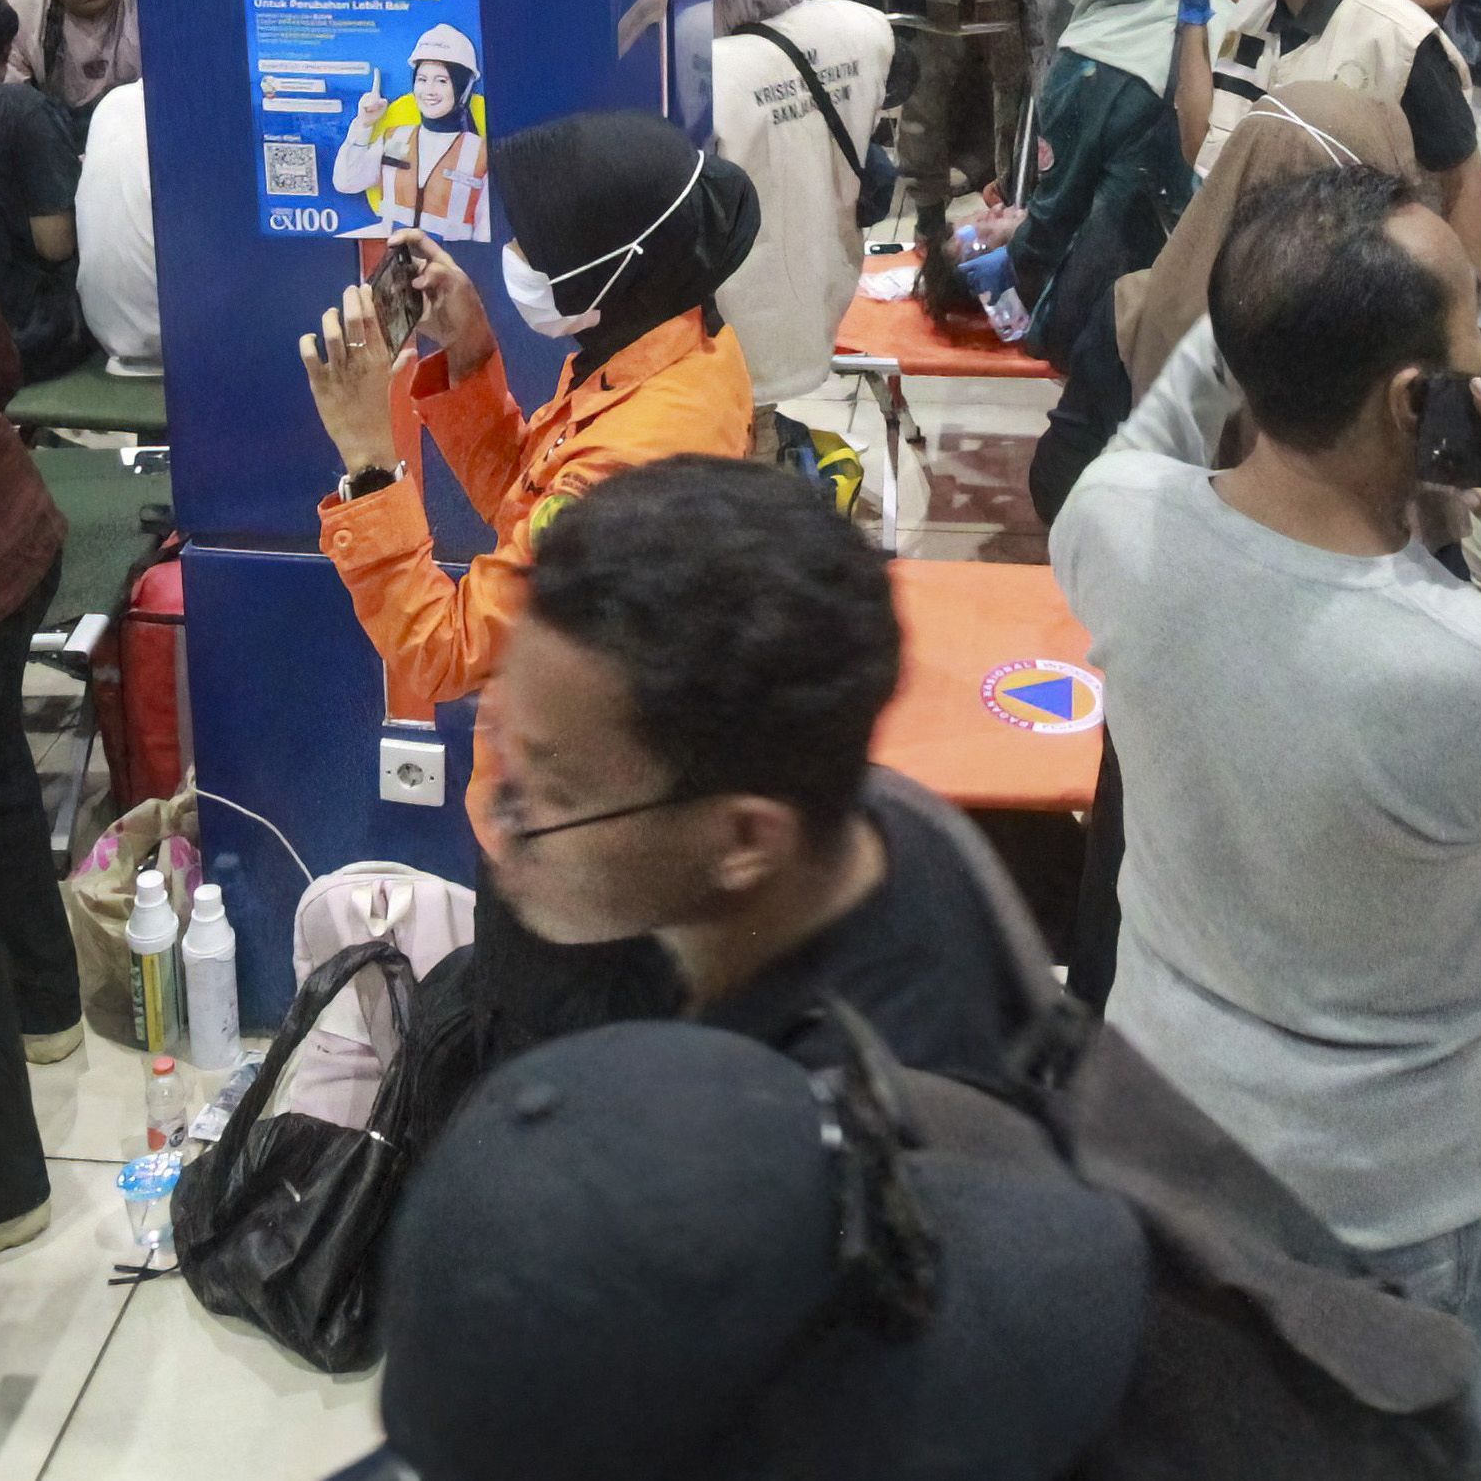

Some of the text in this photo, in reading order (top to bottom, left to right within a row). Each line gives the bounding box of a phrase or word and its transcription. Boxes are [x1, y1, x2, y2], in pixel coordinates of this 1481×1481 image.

[254, 0, 288, 8] Untuk
[289, 0, 350, 10] Perubahan
[352, 1, 383, 10] Lebih
[754, 80, 797, 107] KRISIS
